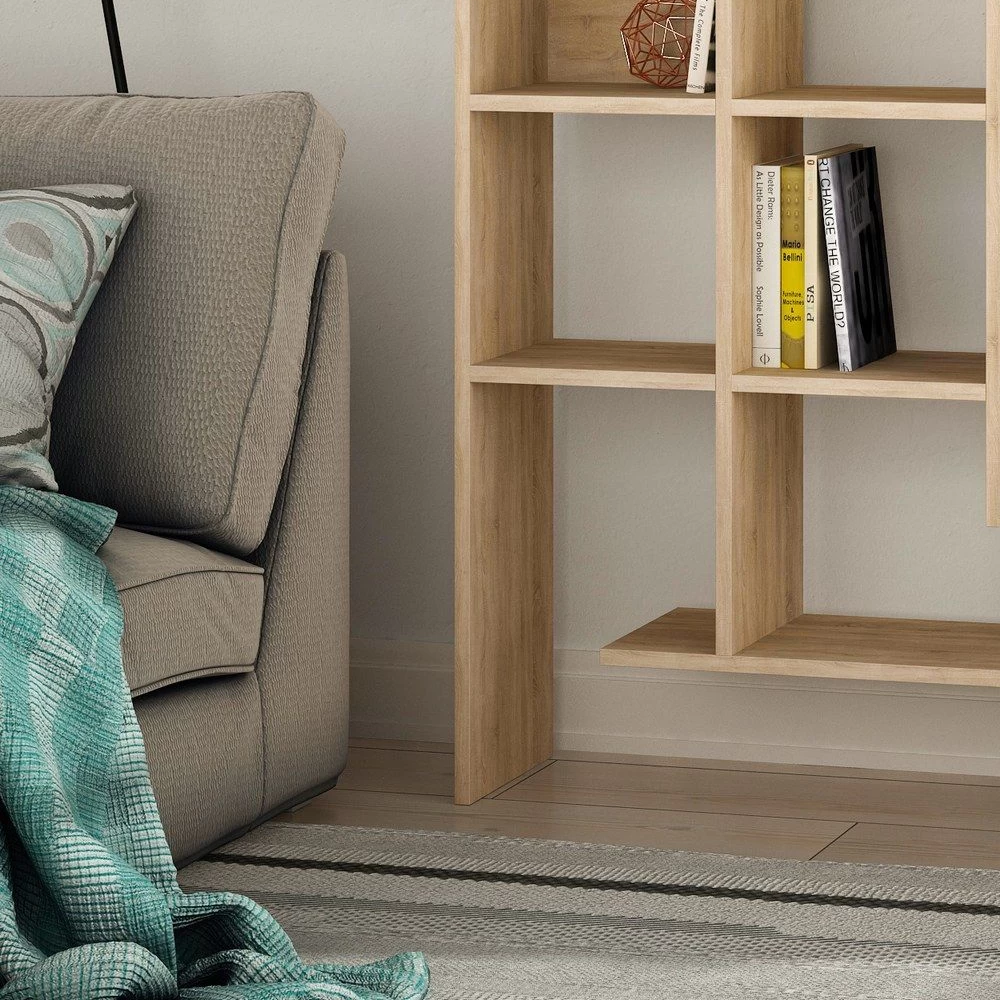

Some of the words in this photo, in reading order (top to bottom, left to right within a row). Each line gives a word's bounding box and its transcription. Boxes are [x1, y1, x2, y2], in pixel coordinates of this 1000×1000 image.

[694, 19, 705, 51] Complete
[692, 52, 701, 71] Films
[756, 170, 764, 180] As
[767, 171, 776, 194] Dieter
[756, 182, 764, 203] Little
[755, 204, 764, 230] Design
[820, 178, 836, 235] CHANGE
[756, 232, 764, 240] as
[782, 240, 801, 248] Mario
[756, 241, 764, 272] Possible
[783, 253, 803, 261] Bellini
[828, 240, 840, 266] THE
[756, 286, 764, 312] Sophie
[830, 270, 845, 328] WORLD?
[756, 315, 764, 337] Lovell
